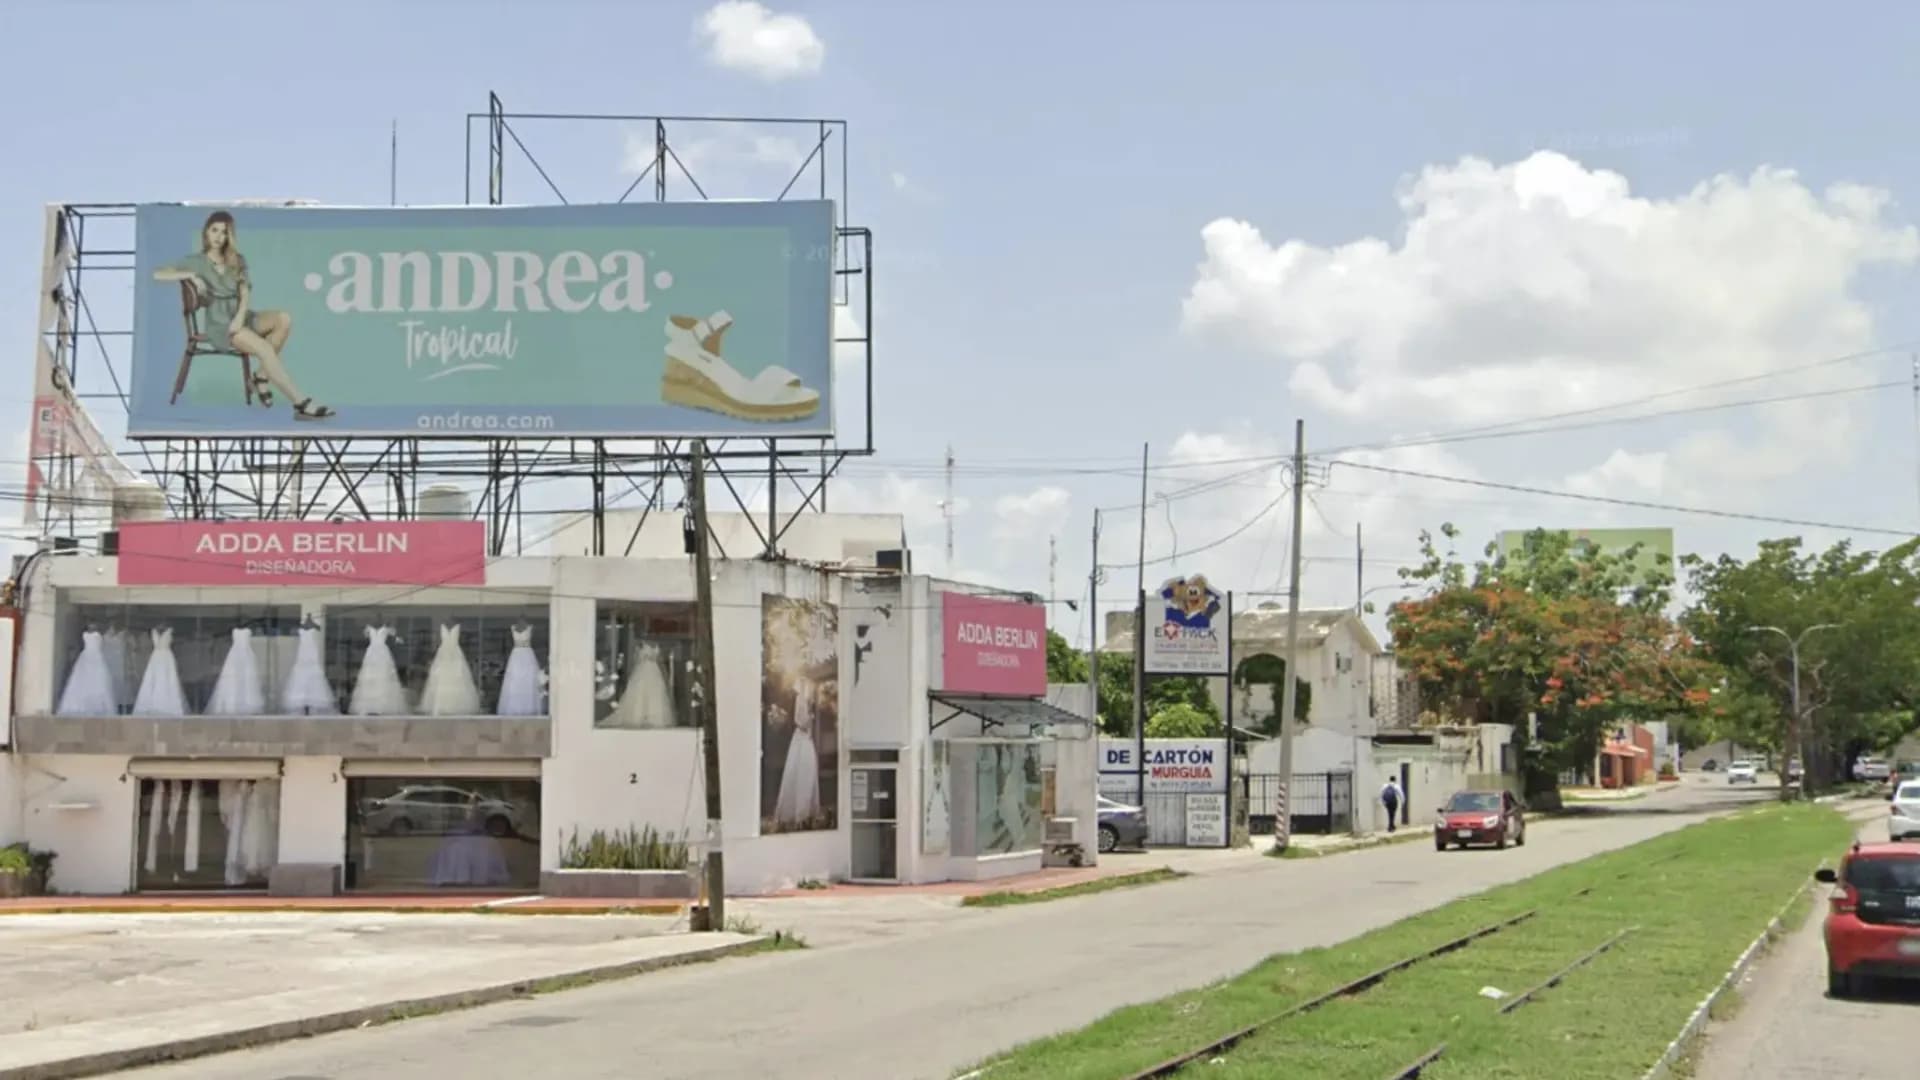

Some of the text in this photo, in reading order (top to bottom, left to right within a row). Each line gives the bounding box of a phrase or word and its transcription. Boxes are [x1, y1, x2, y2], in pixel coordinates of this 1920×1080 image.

[398, 320, 519, 368] Tropical
[416, 411, 554, 429] andrea.com
[196, 532, 408, 553] ADDA BERLIN
[245, 557, 356, 575] DISEÑADORA
[957, 622, 1038, 649] ADDA BERLIN
[1107, 744, 1214, 764] DE CARTÓN
[629, 772, 638, 784] 2
